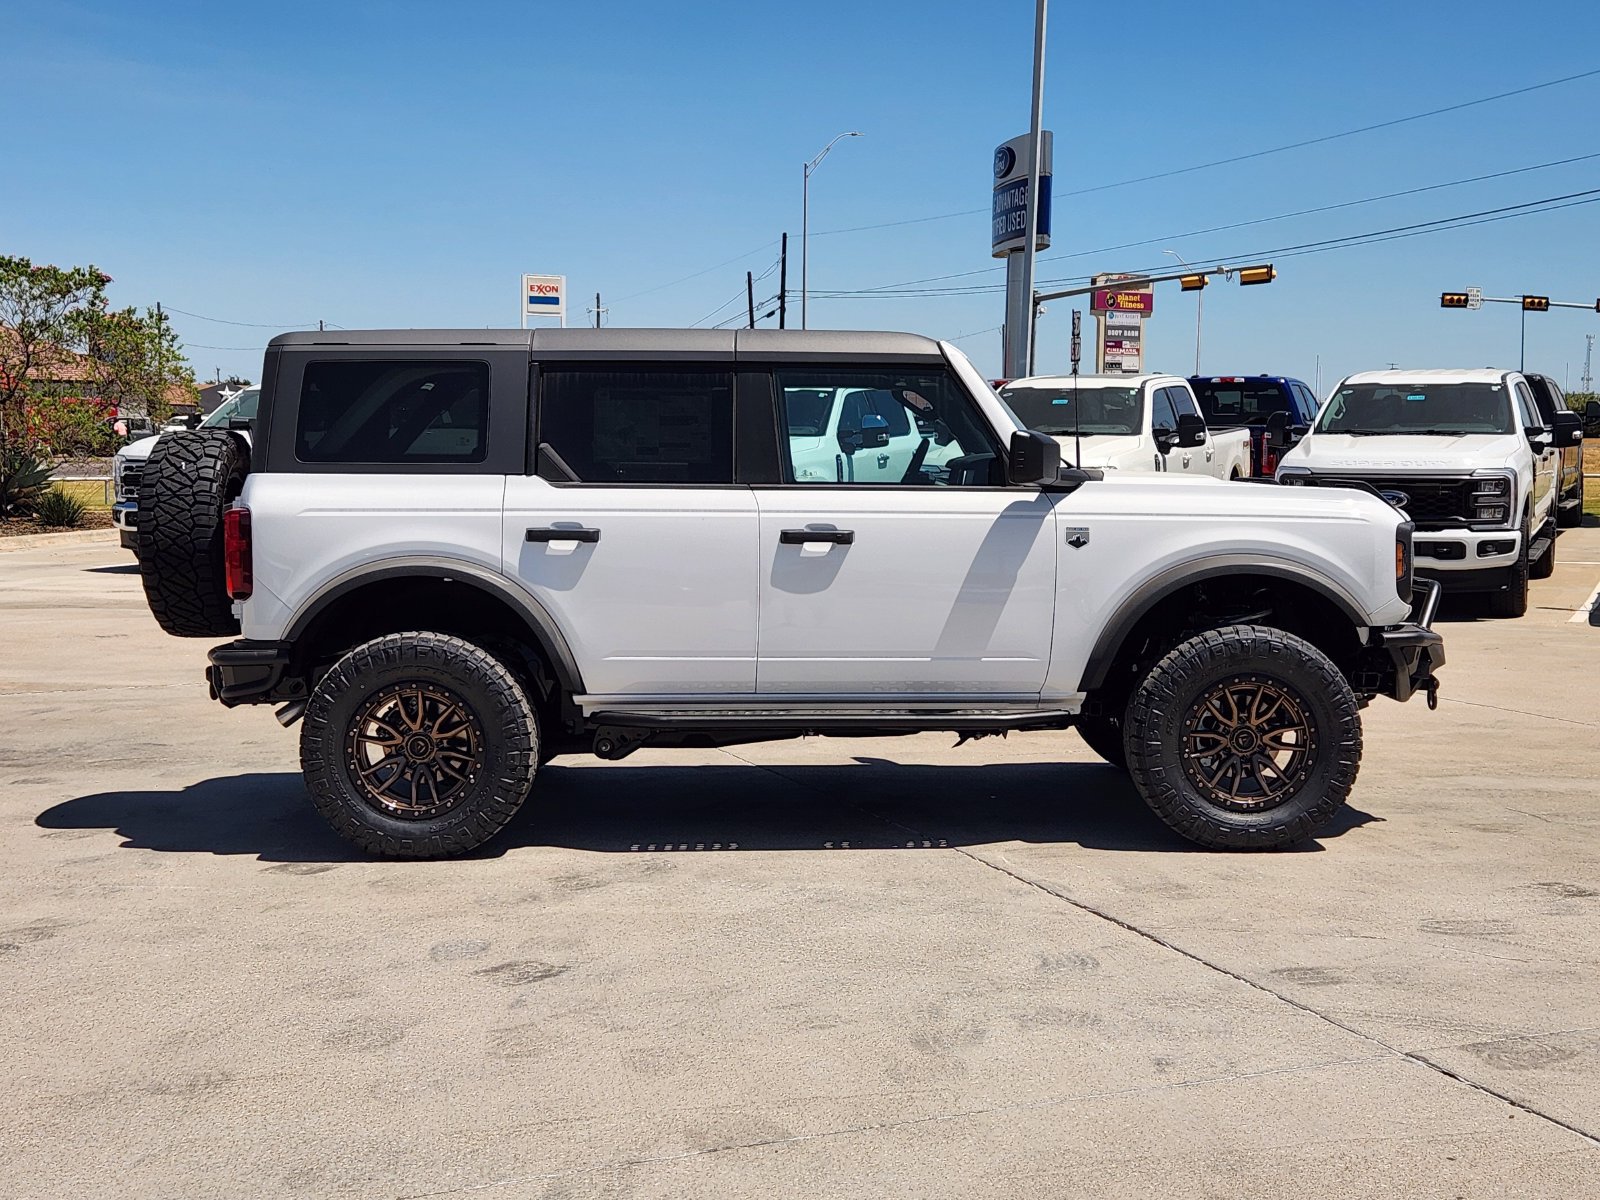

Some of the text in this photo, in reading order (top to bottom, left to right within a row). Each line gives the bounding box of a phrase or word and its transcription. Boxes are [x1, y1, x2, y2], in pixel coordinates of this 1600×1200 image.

[1007, 210, 1026, 232] USED
[530, 284, 559, 295] EXXON
[1117, 293, 1141, 302] planet
[1120, 301, 1145, 309] fitness
